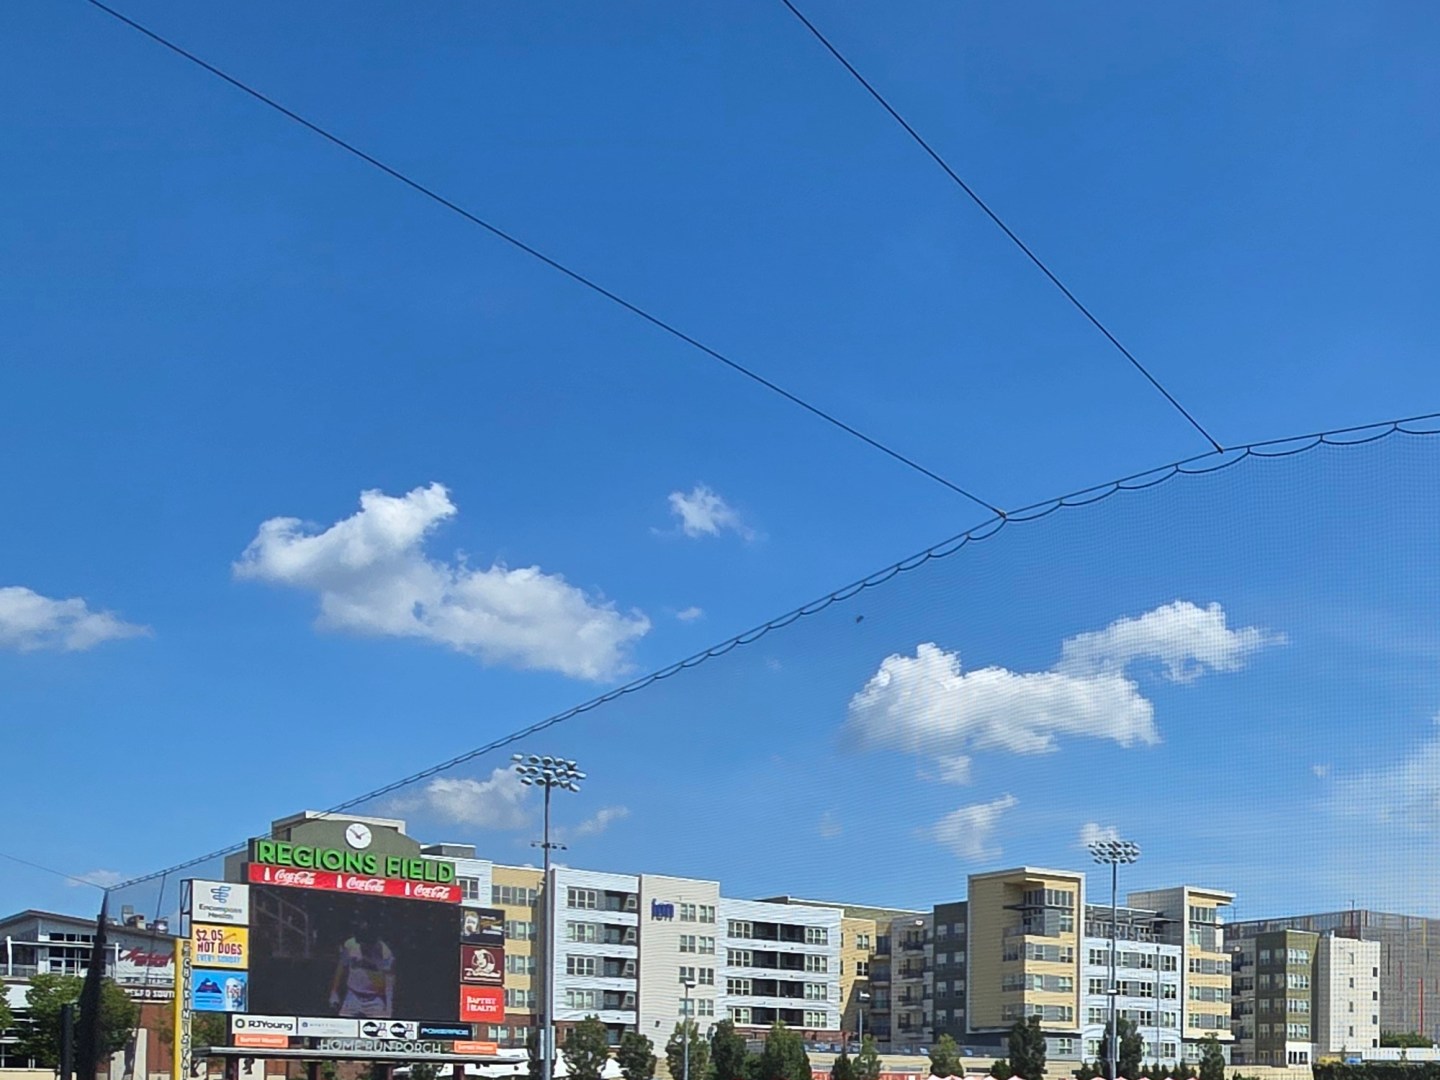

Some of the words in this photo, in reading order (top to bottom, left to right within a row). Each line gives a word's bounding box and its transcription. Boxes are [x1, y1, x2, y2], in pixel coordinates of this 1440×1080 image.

[257, 840, 378, 875] REGIONS
[385, 855, 455, 883] FIELD
[197, 942, 215, 953] HOT
[218, 942, 243, 955] DOGS
[320, 1038, 362, 1051] HOME
[365, 1040, 391, 1052] RUN
[395, 1041, 442, 1054] PORCH
